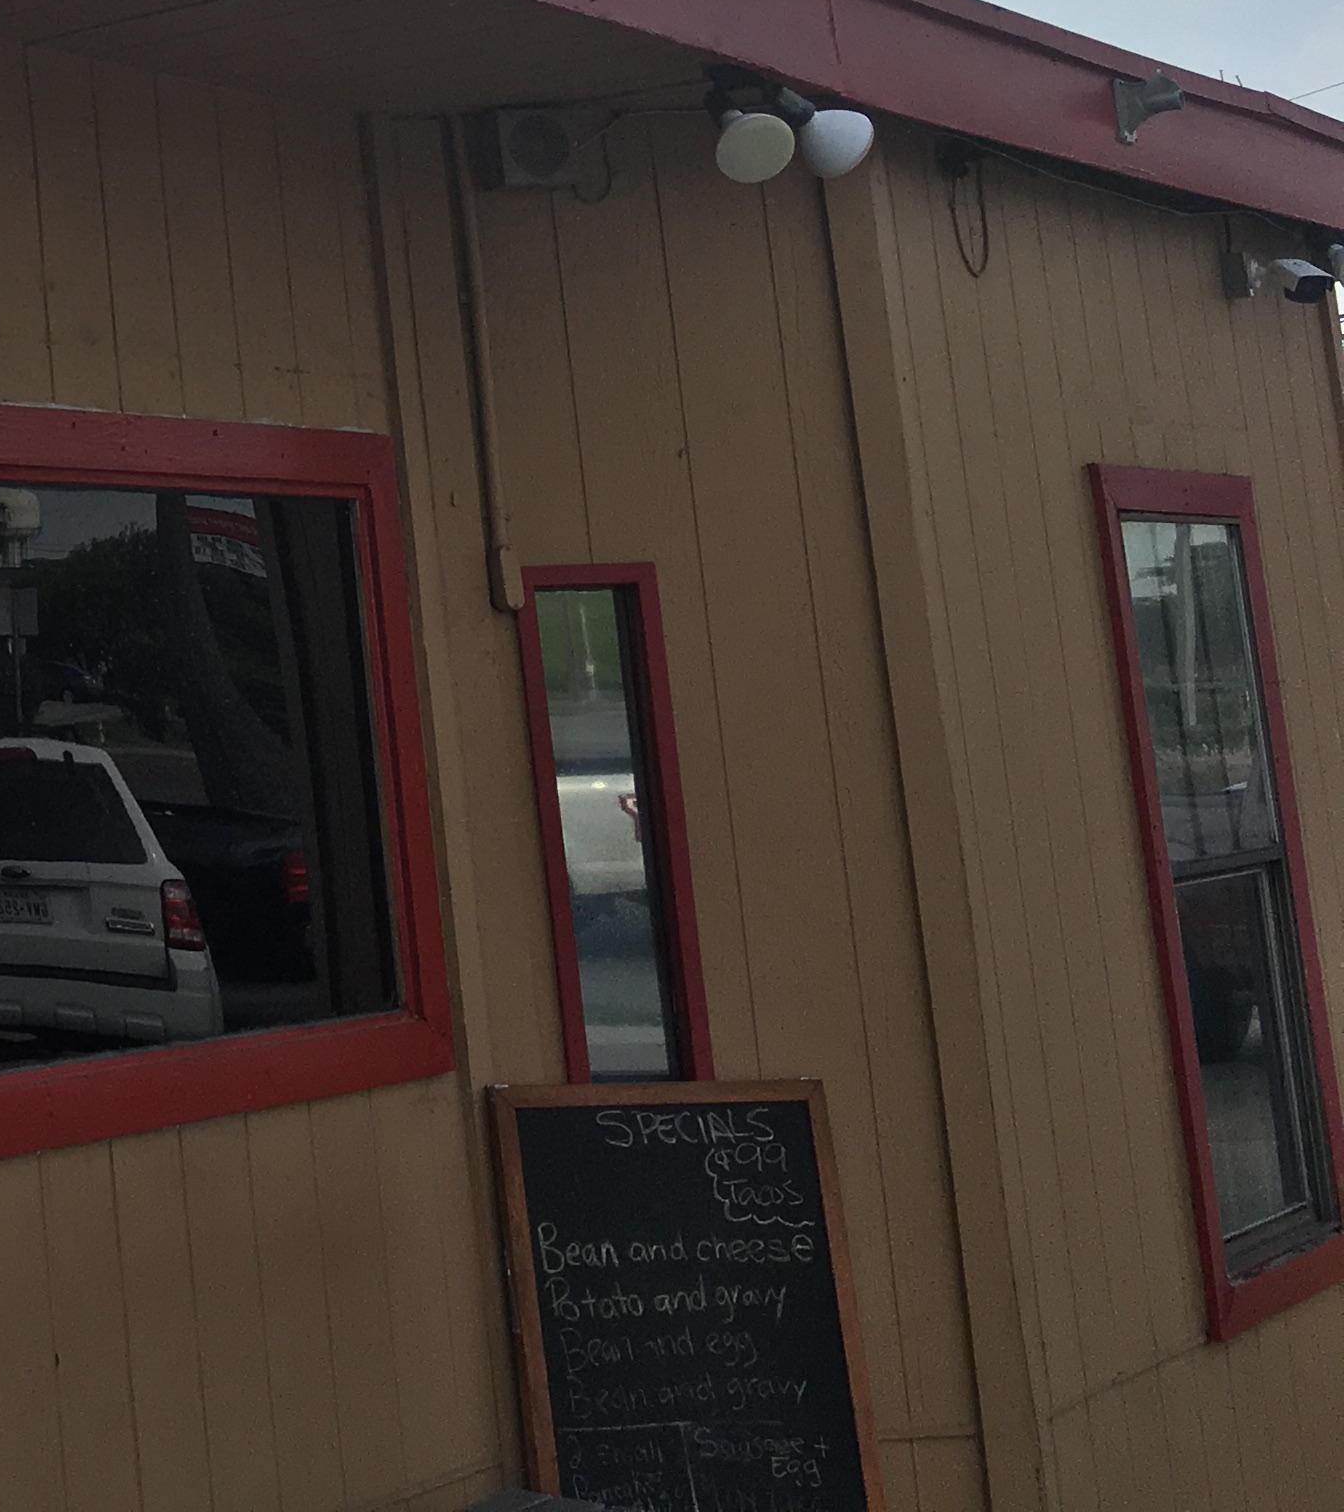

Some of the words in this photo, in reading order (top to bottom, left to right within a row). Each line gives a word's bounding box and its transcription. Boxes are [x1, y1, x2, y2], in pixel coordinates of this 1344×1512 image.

[596, 1107, 775, 1146] SPECIALS
[722, 1179, 804, 1206] Tacos
[537, 1221, 619, 1274] Bean
[628, 1230, 689, 1262] and
[696, 1232, 814, 1263] cheese
[544, 1276, 643, 1321] Potato
[654, 1273, 708, 1313] and
[716, 1285, 787, 1324] gravy
[559, 1327, 634, 1373] Bean
[706, 1331, 758, 1367] egg
[727, 1375, 808, 1411] gravy
